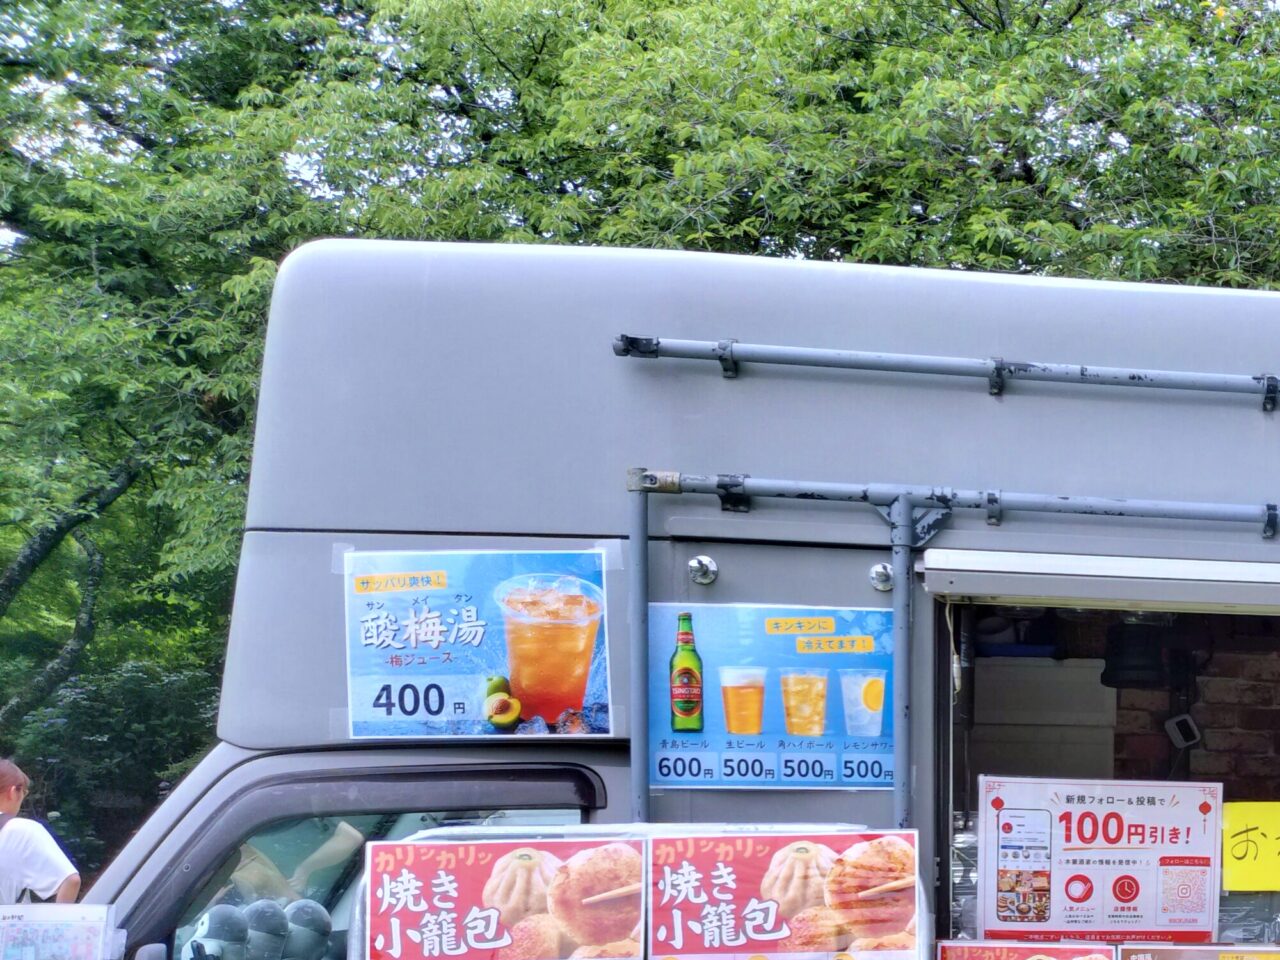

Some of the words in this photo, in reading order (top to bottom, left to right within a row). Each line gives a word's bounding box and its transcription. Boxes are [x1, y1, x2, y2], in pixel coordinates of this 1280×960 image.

[366, 601, 385, 610] サン
[412, 596, 429, 606] メイ
[454, 594, 473, 603] タン
[360, 605, 488, 651] 酸梅湯
[772, 621, 829, 631] キンキンに
[659, 739, 710, 750] 青島ビール
[725, 740, 766, 750] 生ビール
[777, 741, 834, 751] 角ハイボール
[658, 757, 713, 779] 600円
[723, 758, 775, 780] 500円
[783, 759, 834, 780] 500円
[843, 760, 894, 781] 500円
[1058, 811, 1191, 845] 100円引き！
[375, 845, 492, 872] カリッカリッ
[656, 838, 771, 865] カリッカリッ
[376, 868, 459, 914] 焼き
[657, 860, 737, 906] 焼き
[374, 906, 513, 959] 小籠包
[657, 897, 791, 949] 小籠包
